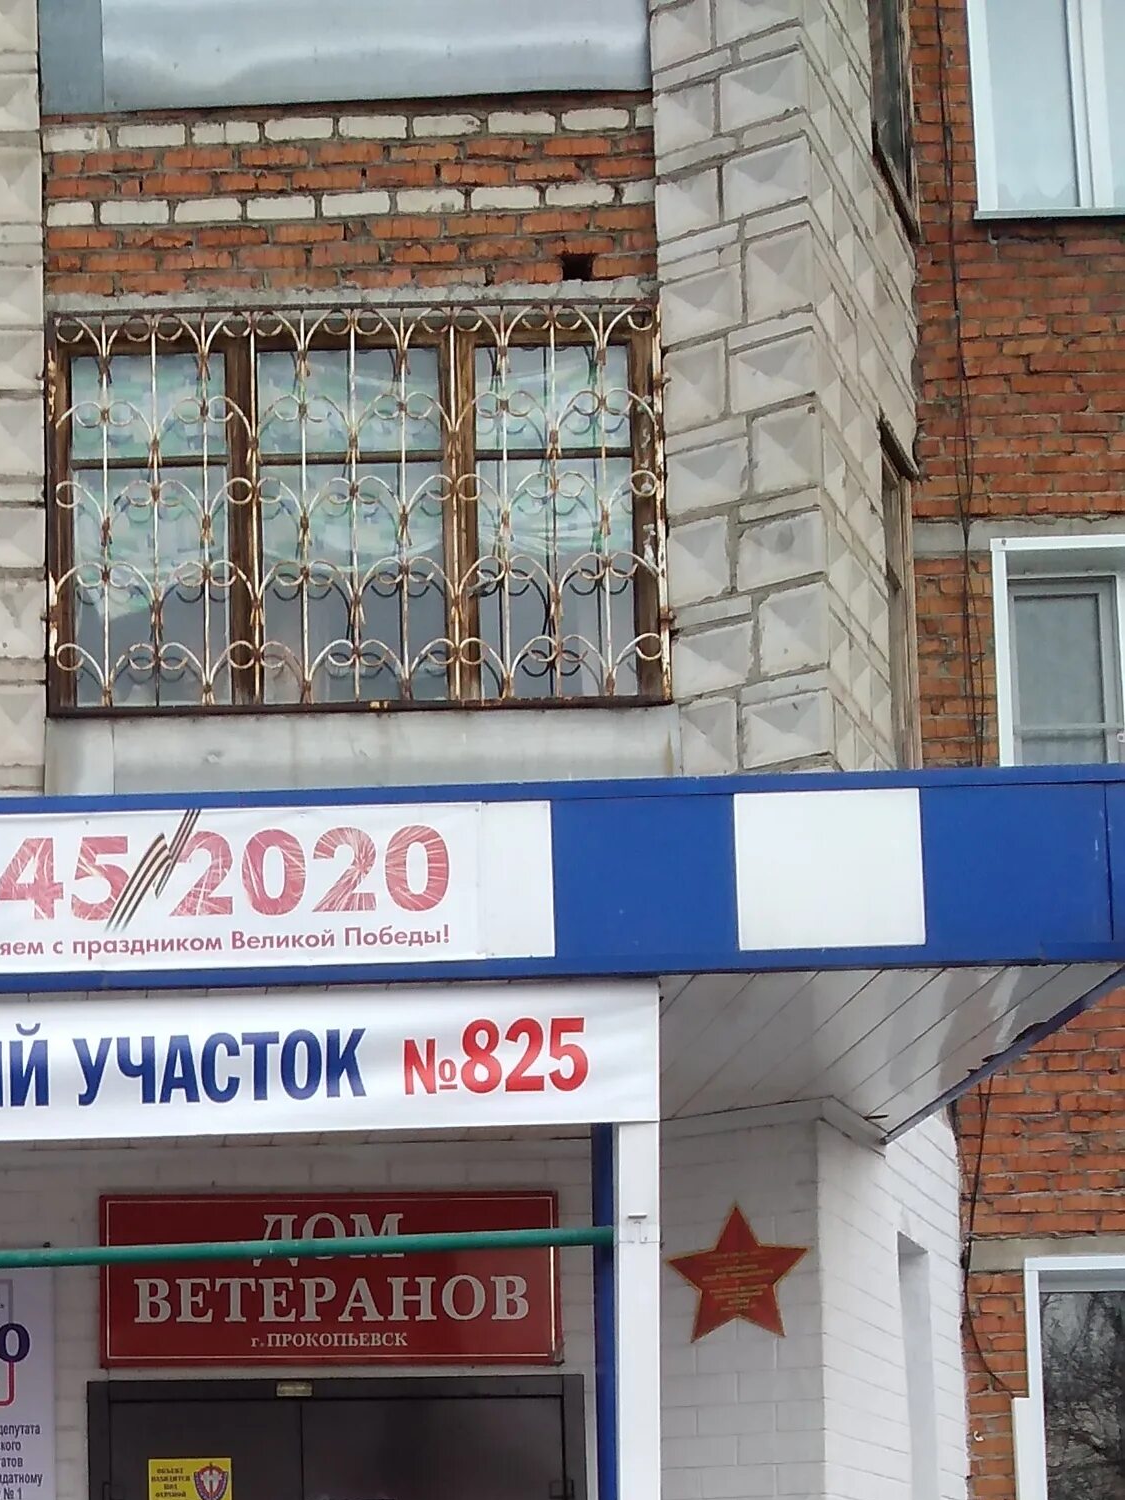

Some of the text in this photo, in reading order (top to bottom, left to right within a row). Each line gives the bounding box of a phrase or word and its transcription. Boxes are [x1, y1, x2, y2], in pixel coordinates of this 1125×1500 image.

[169, 824, 451, 919] 2020
[52, 942, 64, 955] с
[73, 936, 223, 960] праздником
[231, 929, 335, 950] Великой
[344, 924, 450, 948] Победы!
[75, 1026, 369, 1108] УЧАСТОК
[403, 1016, 590, 1096] №825
[252, 1212, 405, 1268] ДОМ
[133, 1275, 530, 1324] ВЕТЕРАНОВ
[3, 1488, 14, 1500] №
[17, 1488, 23, 1500] 1
